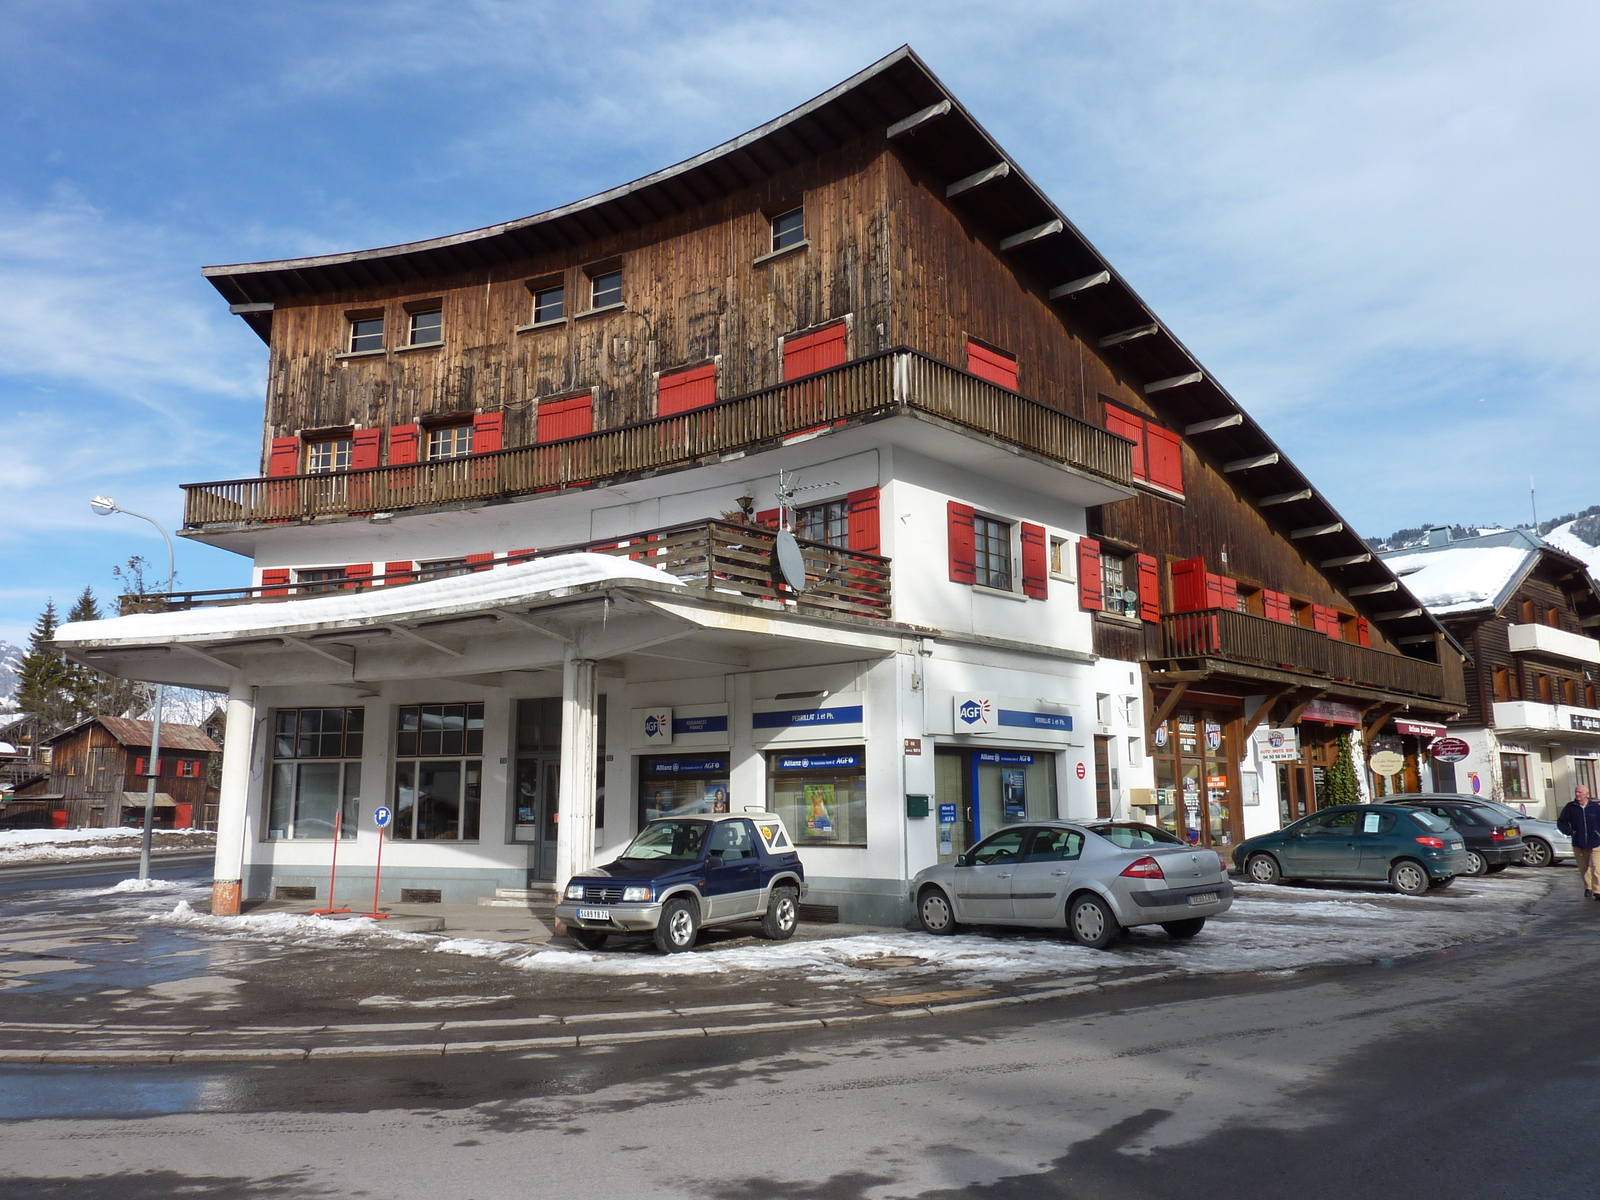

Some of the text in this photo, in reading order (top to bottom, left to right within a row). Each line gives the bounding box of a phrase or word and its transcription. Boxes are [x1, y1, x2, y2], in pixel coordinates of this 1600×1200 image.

[961, 707, 980, 718] AGF
[646, 721, 658, 731] AGF
[836, 757, 849, 765] AGF
[378, 810, 386, 820] P
